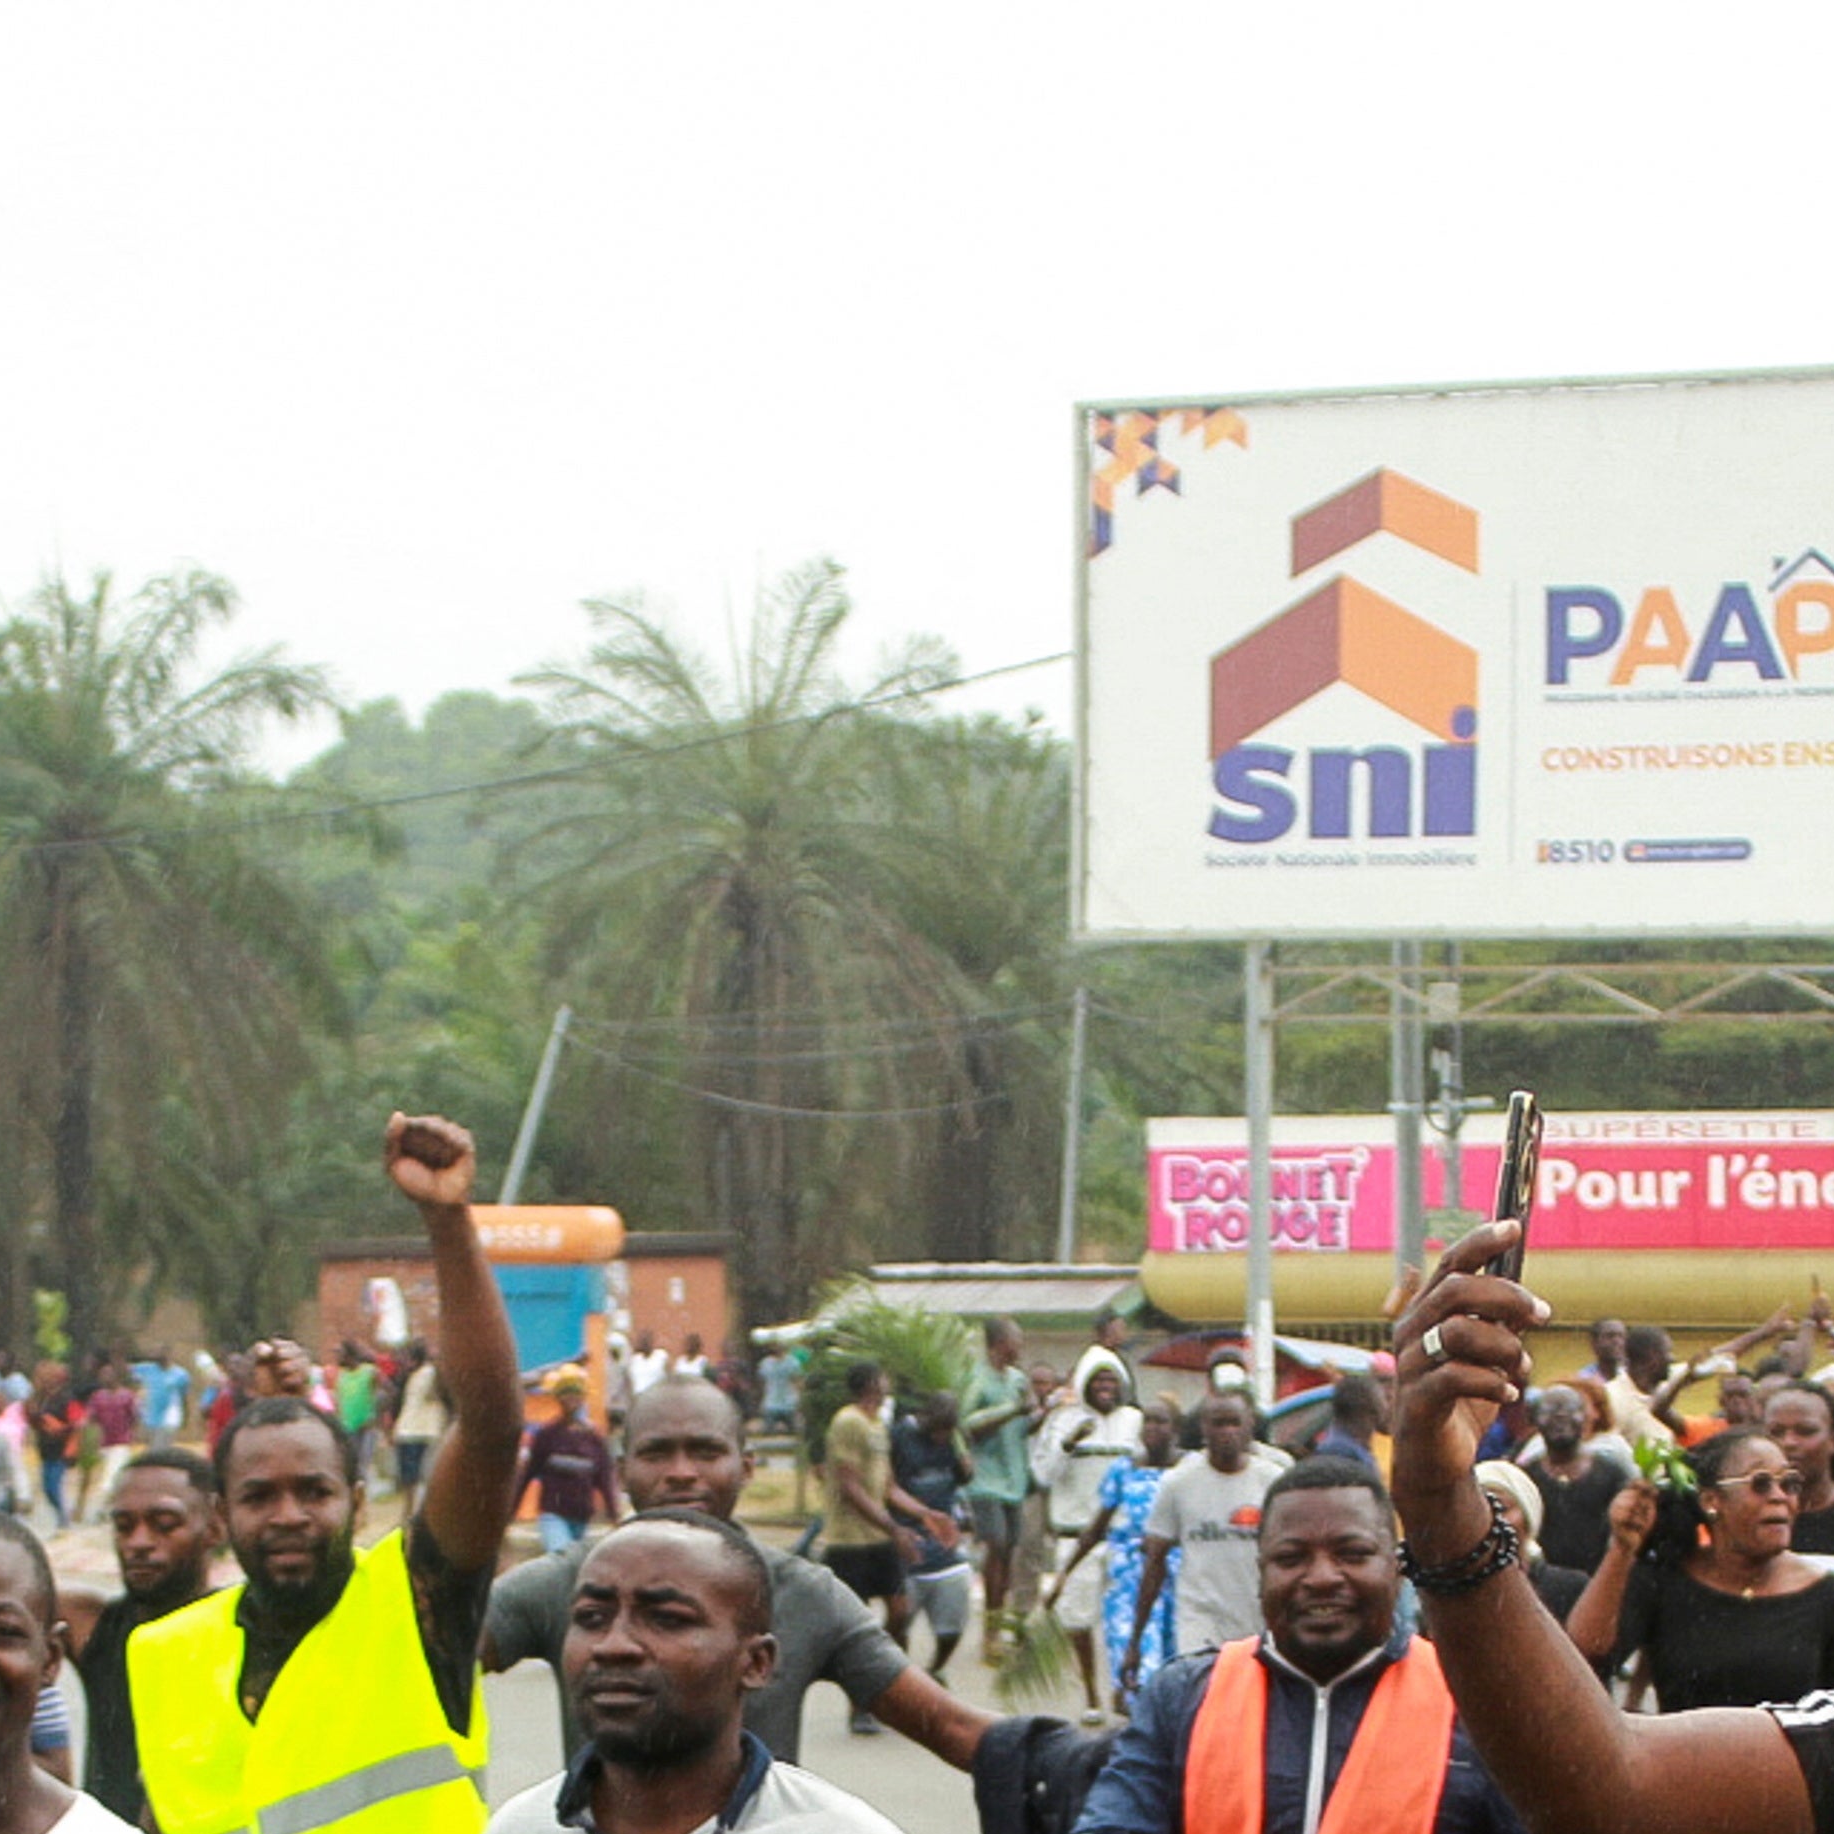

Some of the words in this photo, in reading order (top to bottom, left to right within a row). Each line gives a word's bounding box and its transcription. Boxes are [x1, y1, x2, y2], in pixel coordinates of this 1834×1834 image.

[1206, 703, 1478, 844] sni
[1540, 743, 1777, 772] CONSTRUISONS
[1537, 1157, 1693, 1211] Pour
